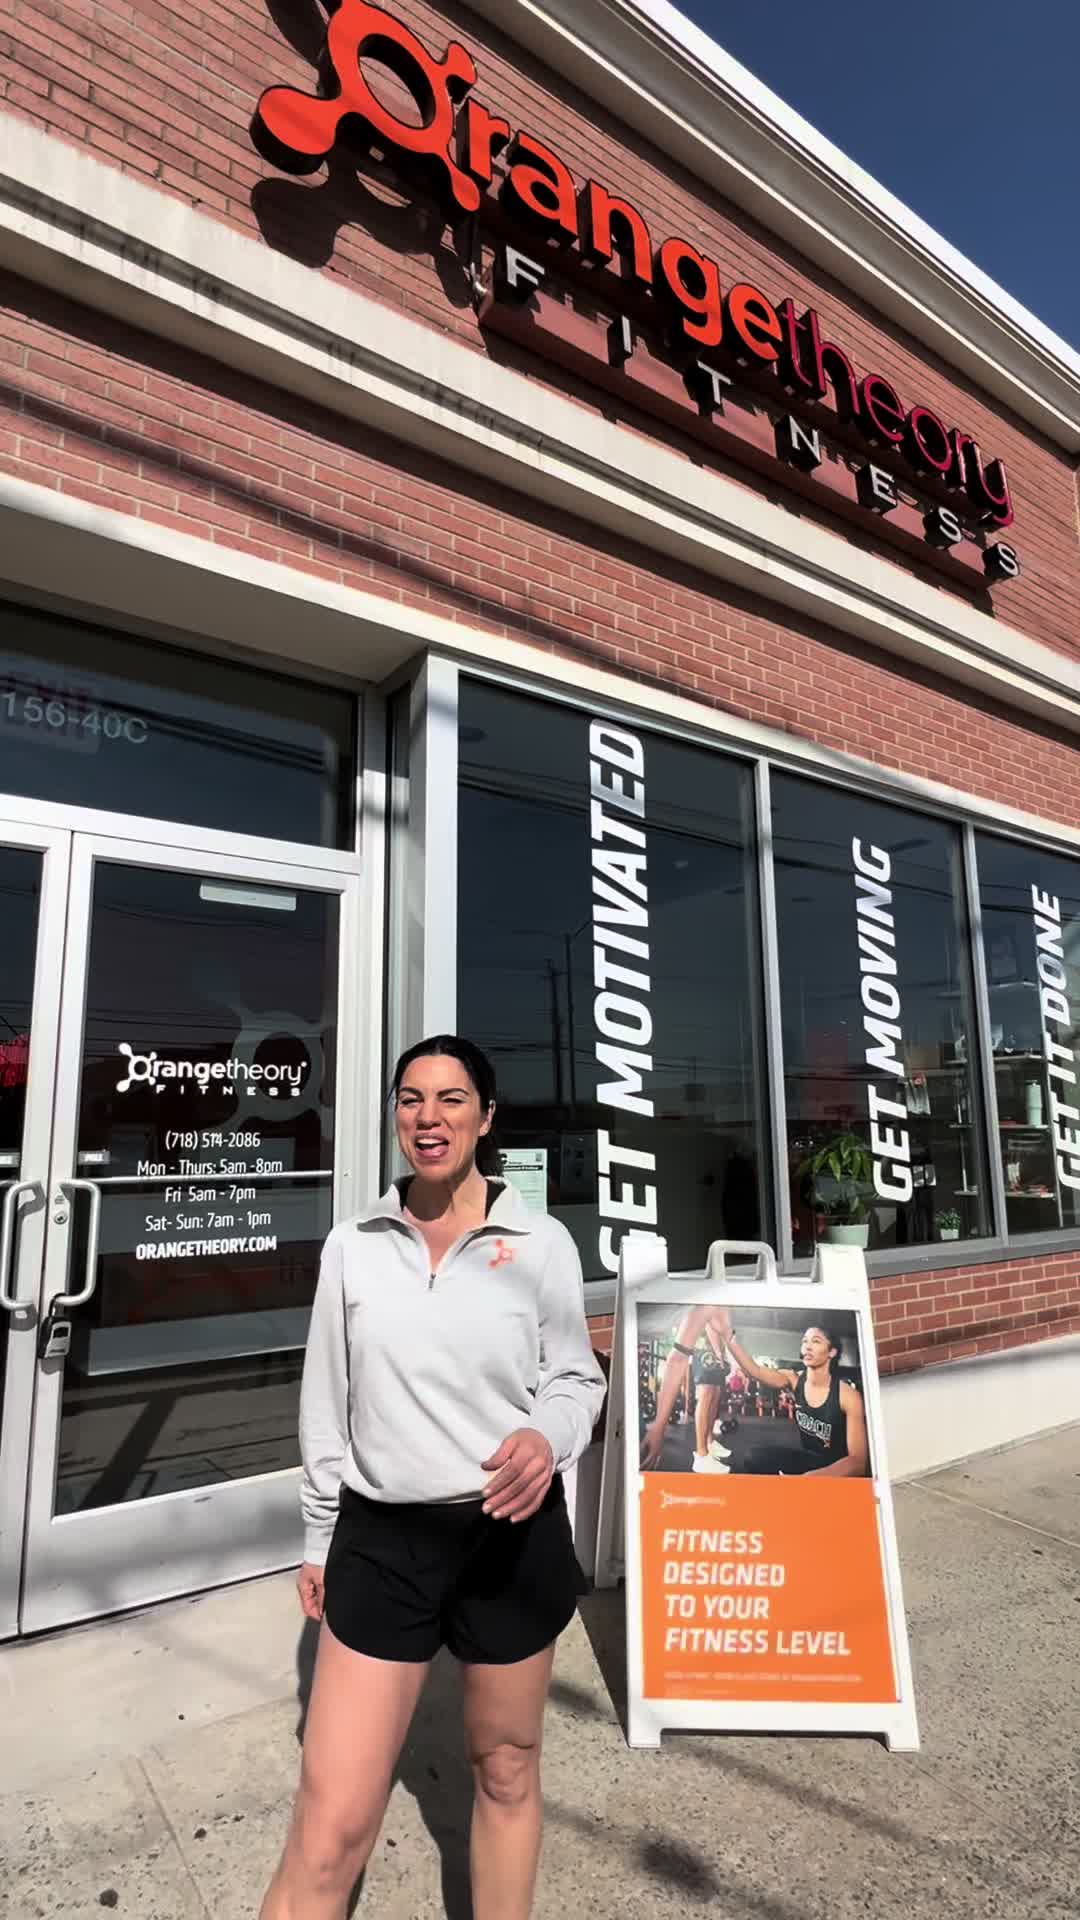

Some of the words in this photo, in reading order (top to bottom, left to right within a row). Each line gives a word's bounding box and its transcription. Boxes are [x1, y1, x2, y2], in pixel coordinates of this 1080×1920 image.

[257, 0, 1014, 527] Orangetheory
[505, 245, 1020, 577] FITNESS
[2, 692, 148, 744] 156-40C
[589, 718, 655, 1117] MOTIVATED
[851, 836, 905, 1077] MOVING
[1031, 883, 1072, 1026] DONE
[1045, 1032, 1076, 1085] IT
[156, 1084, 301, 1097] FITNESS
[165, 1130, 198, 1150] (718)
[867, 1084, 914, 1203] GET
[1051, 1091, 1080, 1191] GET
[137, 1160, 166, 1177] Mon
[179, 1159, 217, 1176] Thurs:
[219, 1158, 247, 1175] 5am
[165, 1187, 181, 1203] Fri
[188, 1186, 216, 1202] 5am
[229, 1185, 256, 1204] 7pm
[176, 1214, 204, 1231] Sun:
[207, 1213, 234, 1229] 7am
[247, 1210, 271, 1230] 1pm
[136, 1236, 277, 1261] ORANGETHEORY.COM
[662, 1528, 764, 1554] FITNESS
[663, 1560, 785, 1587] DESIGNED
[664, 1594, 697, 1618] TO
[703, 1595, 770, 1619] YOUR
[664, 1627, 769, 1654] FITNESS
[775, 1630, 852, 1656] LEVEL
